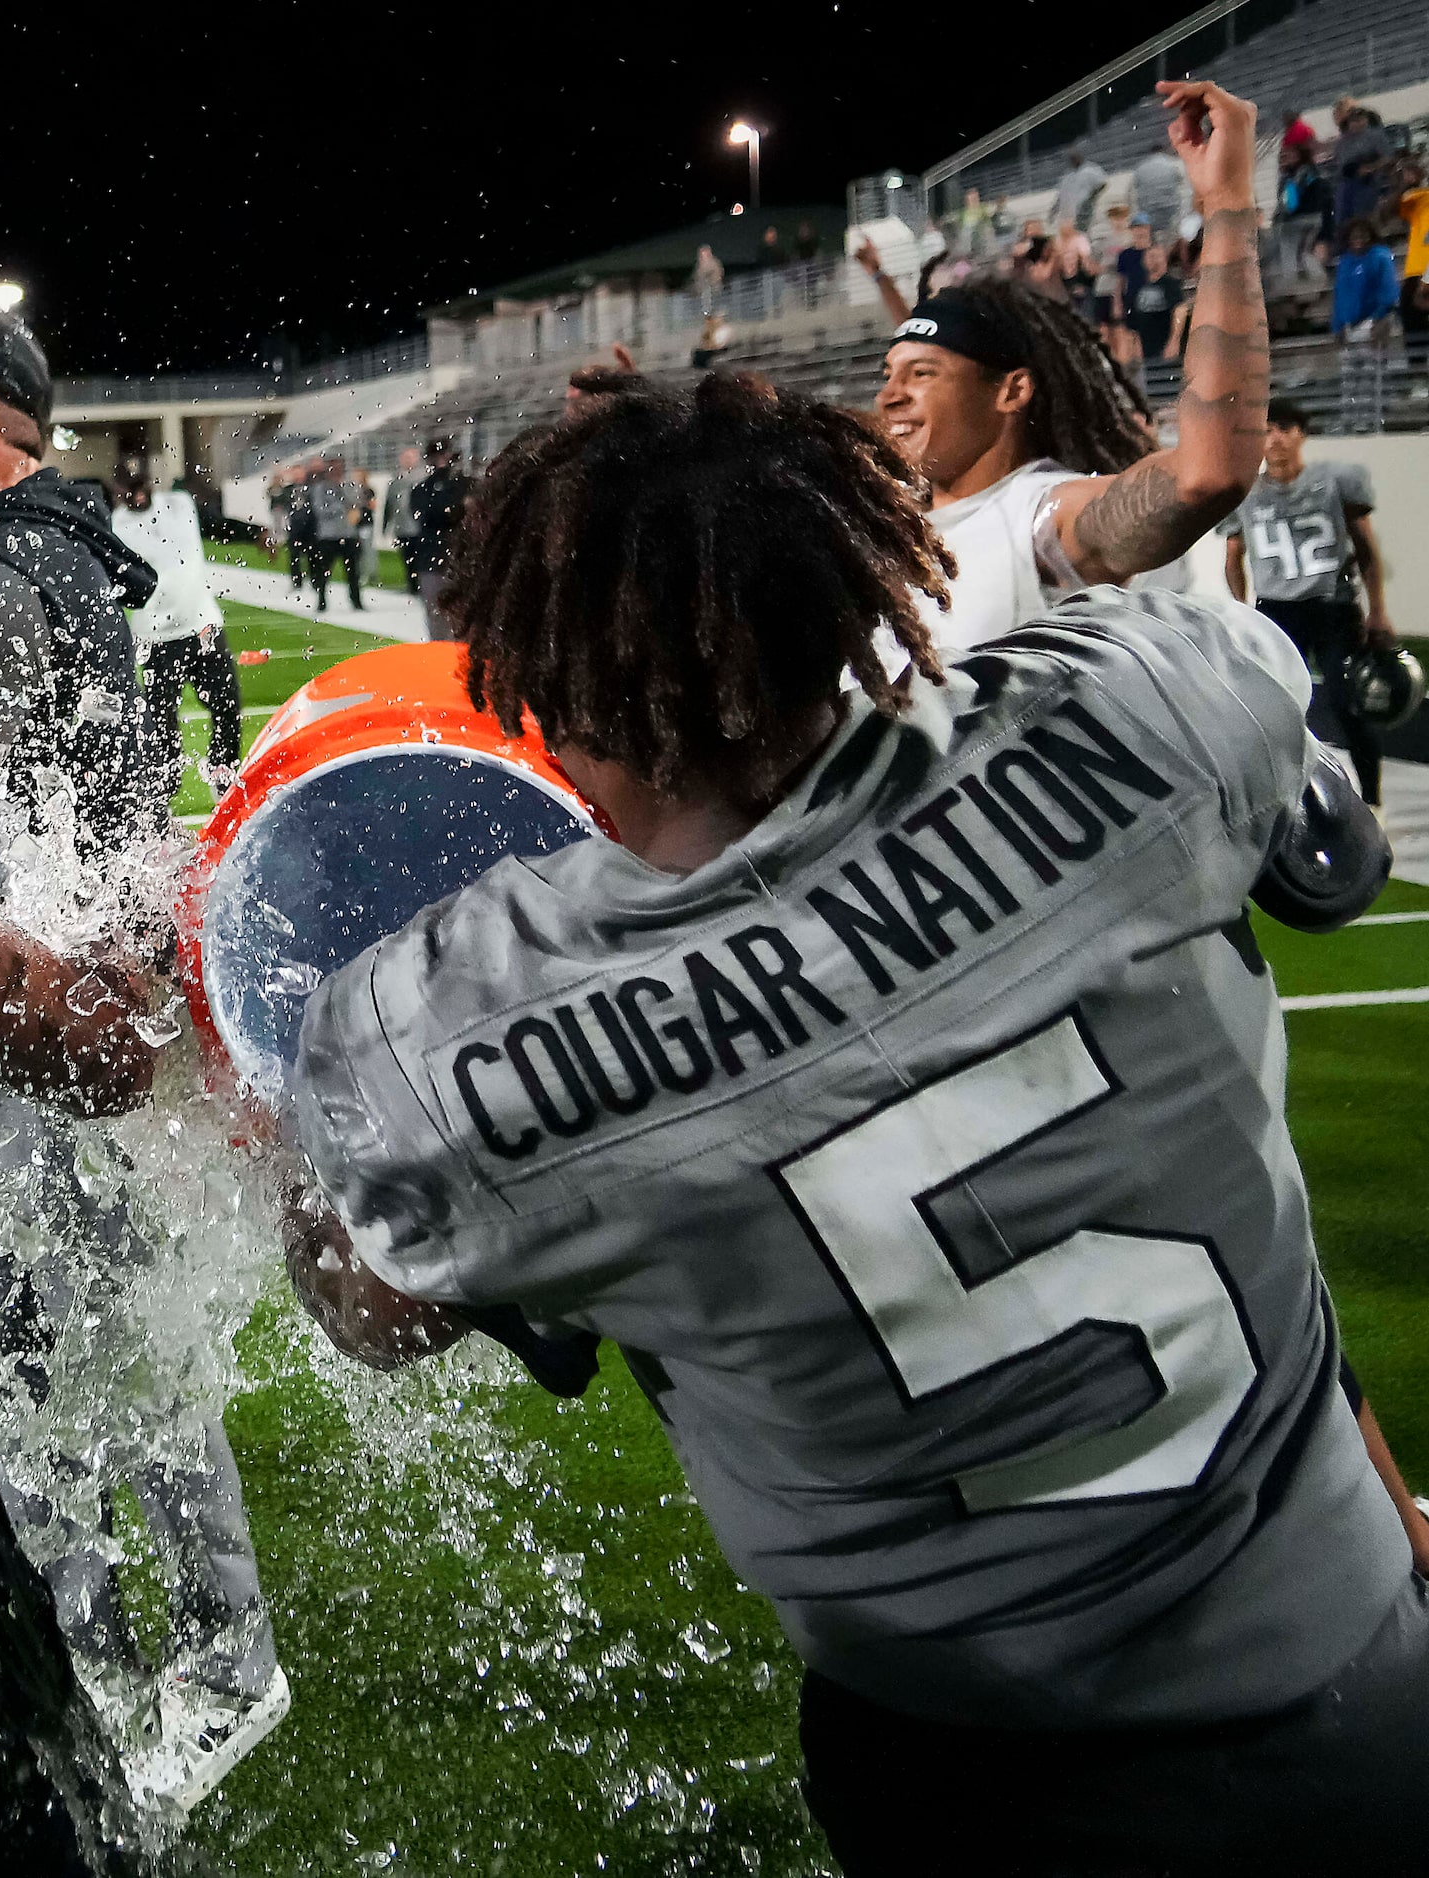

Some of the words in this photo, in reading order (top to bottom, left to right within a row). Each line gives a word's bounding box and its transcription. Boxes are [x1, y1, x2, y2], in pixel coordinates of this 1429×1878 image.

[1253, 511, 1340, 581] 42
[452, 925, 848, 1160] COUGAR
[806, 698, 1174, 996] NATION
[769, 1002, 1267, 1519] 5
